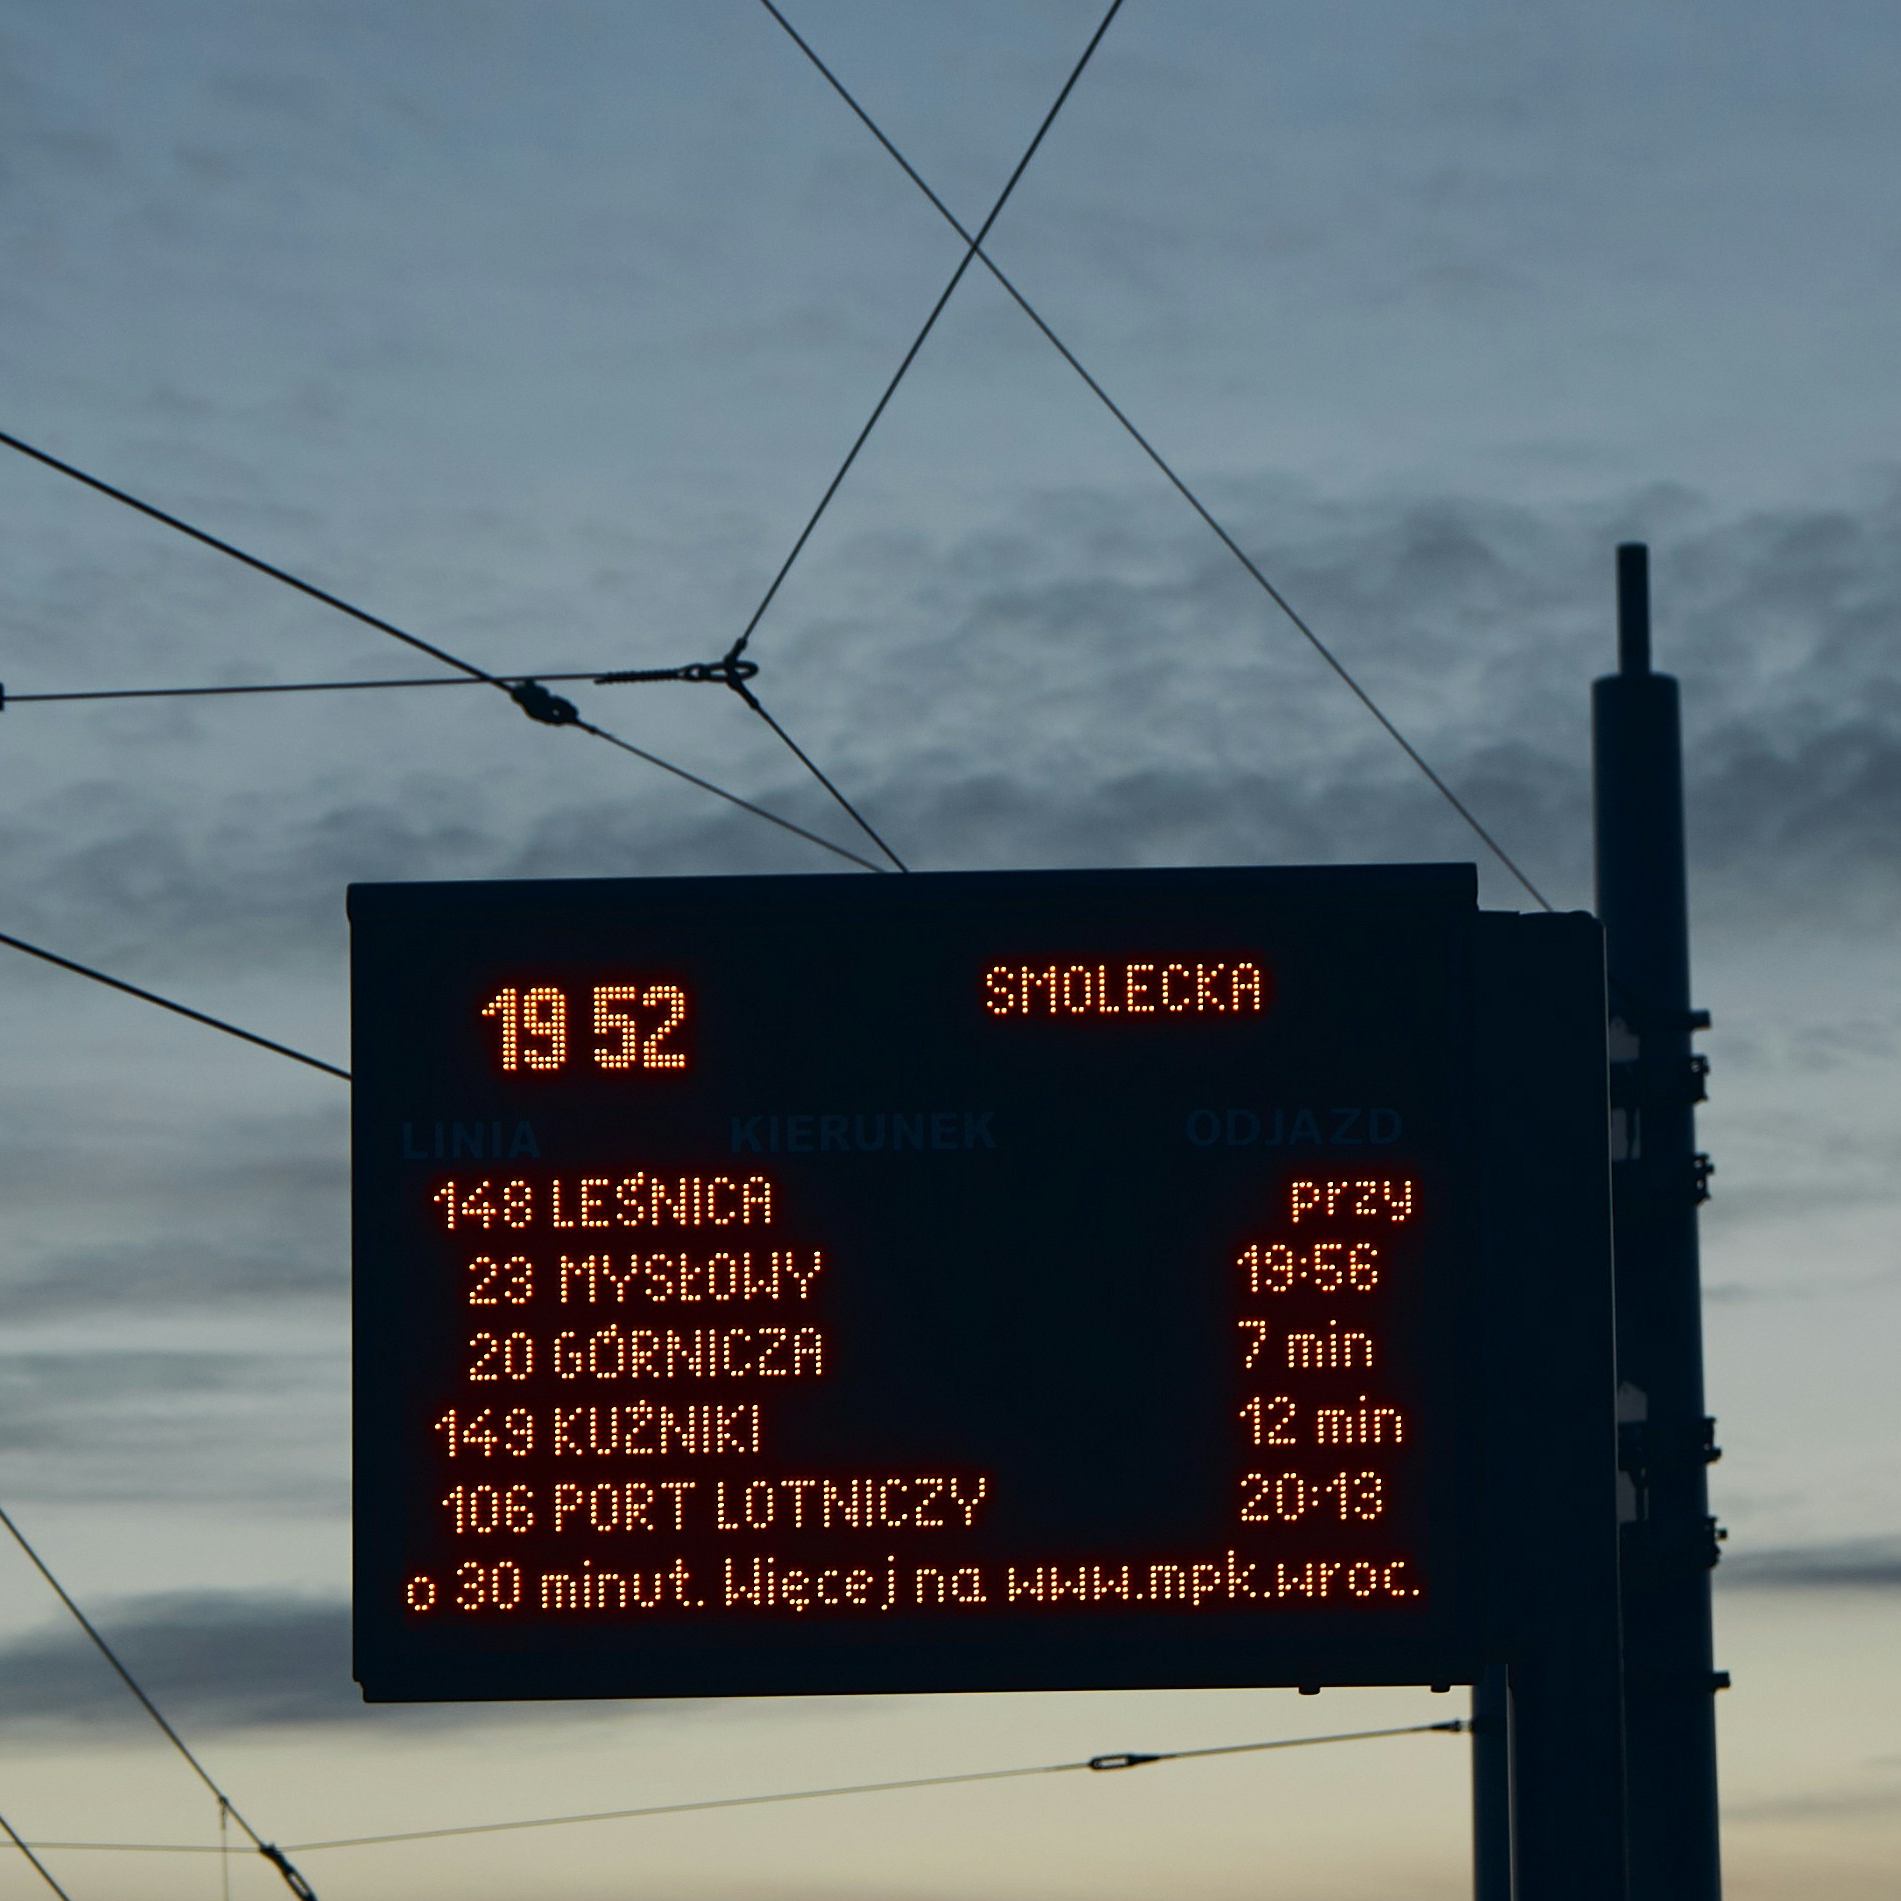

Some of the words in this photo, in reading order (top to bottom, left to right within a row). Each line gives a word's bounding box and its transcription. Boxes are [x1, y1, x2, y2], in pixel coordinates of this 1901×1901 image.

[987, 963, 1260, 1015] SMOLECKA
[482, 988, 566, 1071] 19
[594, 986, 686, 1069] 52
[401, 1120, 541, 1160] LINIA
[731, 1112, 997, 1154] KIERUNEK
[1186, 1109, 1404, 1147] ODJAZD
[434, 1180, 532, 1229] 148
[553, 1172, 771, 1228] LEŚNICA
[1292, 1181, 1411, 1223] przy
[469, 1256, 533, 1305] 23
[561, 1251, 821, 1303] MYSŁOWY
[1237, 1243, 1378, 1293] 19:56
[470, 1332, 533, 1381] 20
[554, 1324, 821, 1380] GÓRNICZA
[1238, 1320, 1266, 1368] 7
[1288, 1320, 1372, 1368] min
[435, 1408, 533, 1457] 149
[1239, 1396, 1296, 1445] 12
[1317, 1395, 1402, 1444] min
[442, 1485, 534, 1534] 106
[555, 1482, 695, 1532] PORT
[718, 1478, 985, 1530] LOTNICZY
[1241, 1472, 1382, 1522] 20:13
[407, 1577, 435, 1611] o
[457, 1561, 521, 1610] 30
[542, 1559, 704, 1609] minut.
[725, 1555, 895, 1612] Więcej
[917, 1568, 986, 1603] na
[1008, 1550, 1419, 1606] www.mpk.wroc.
